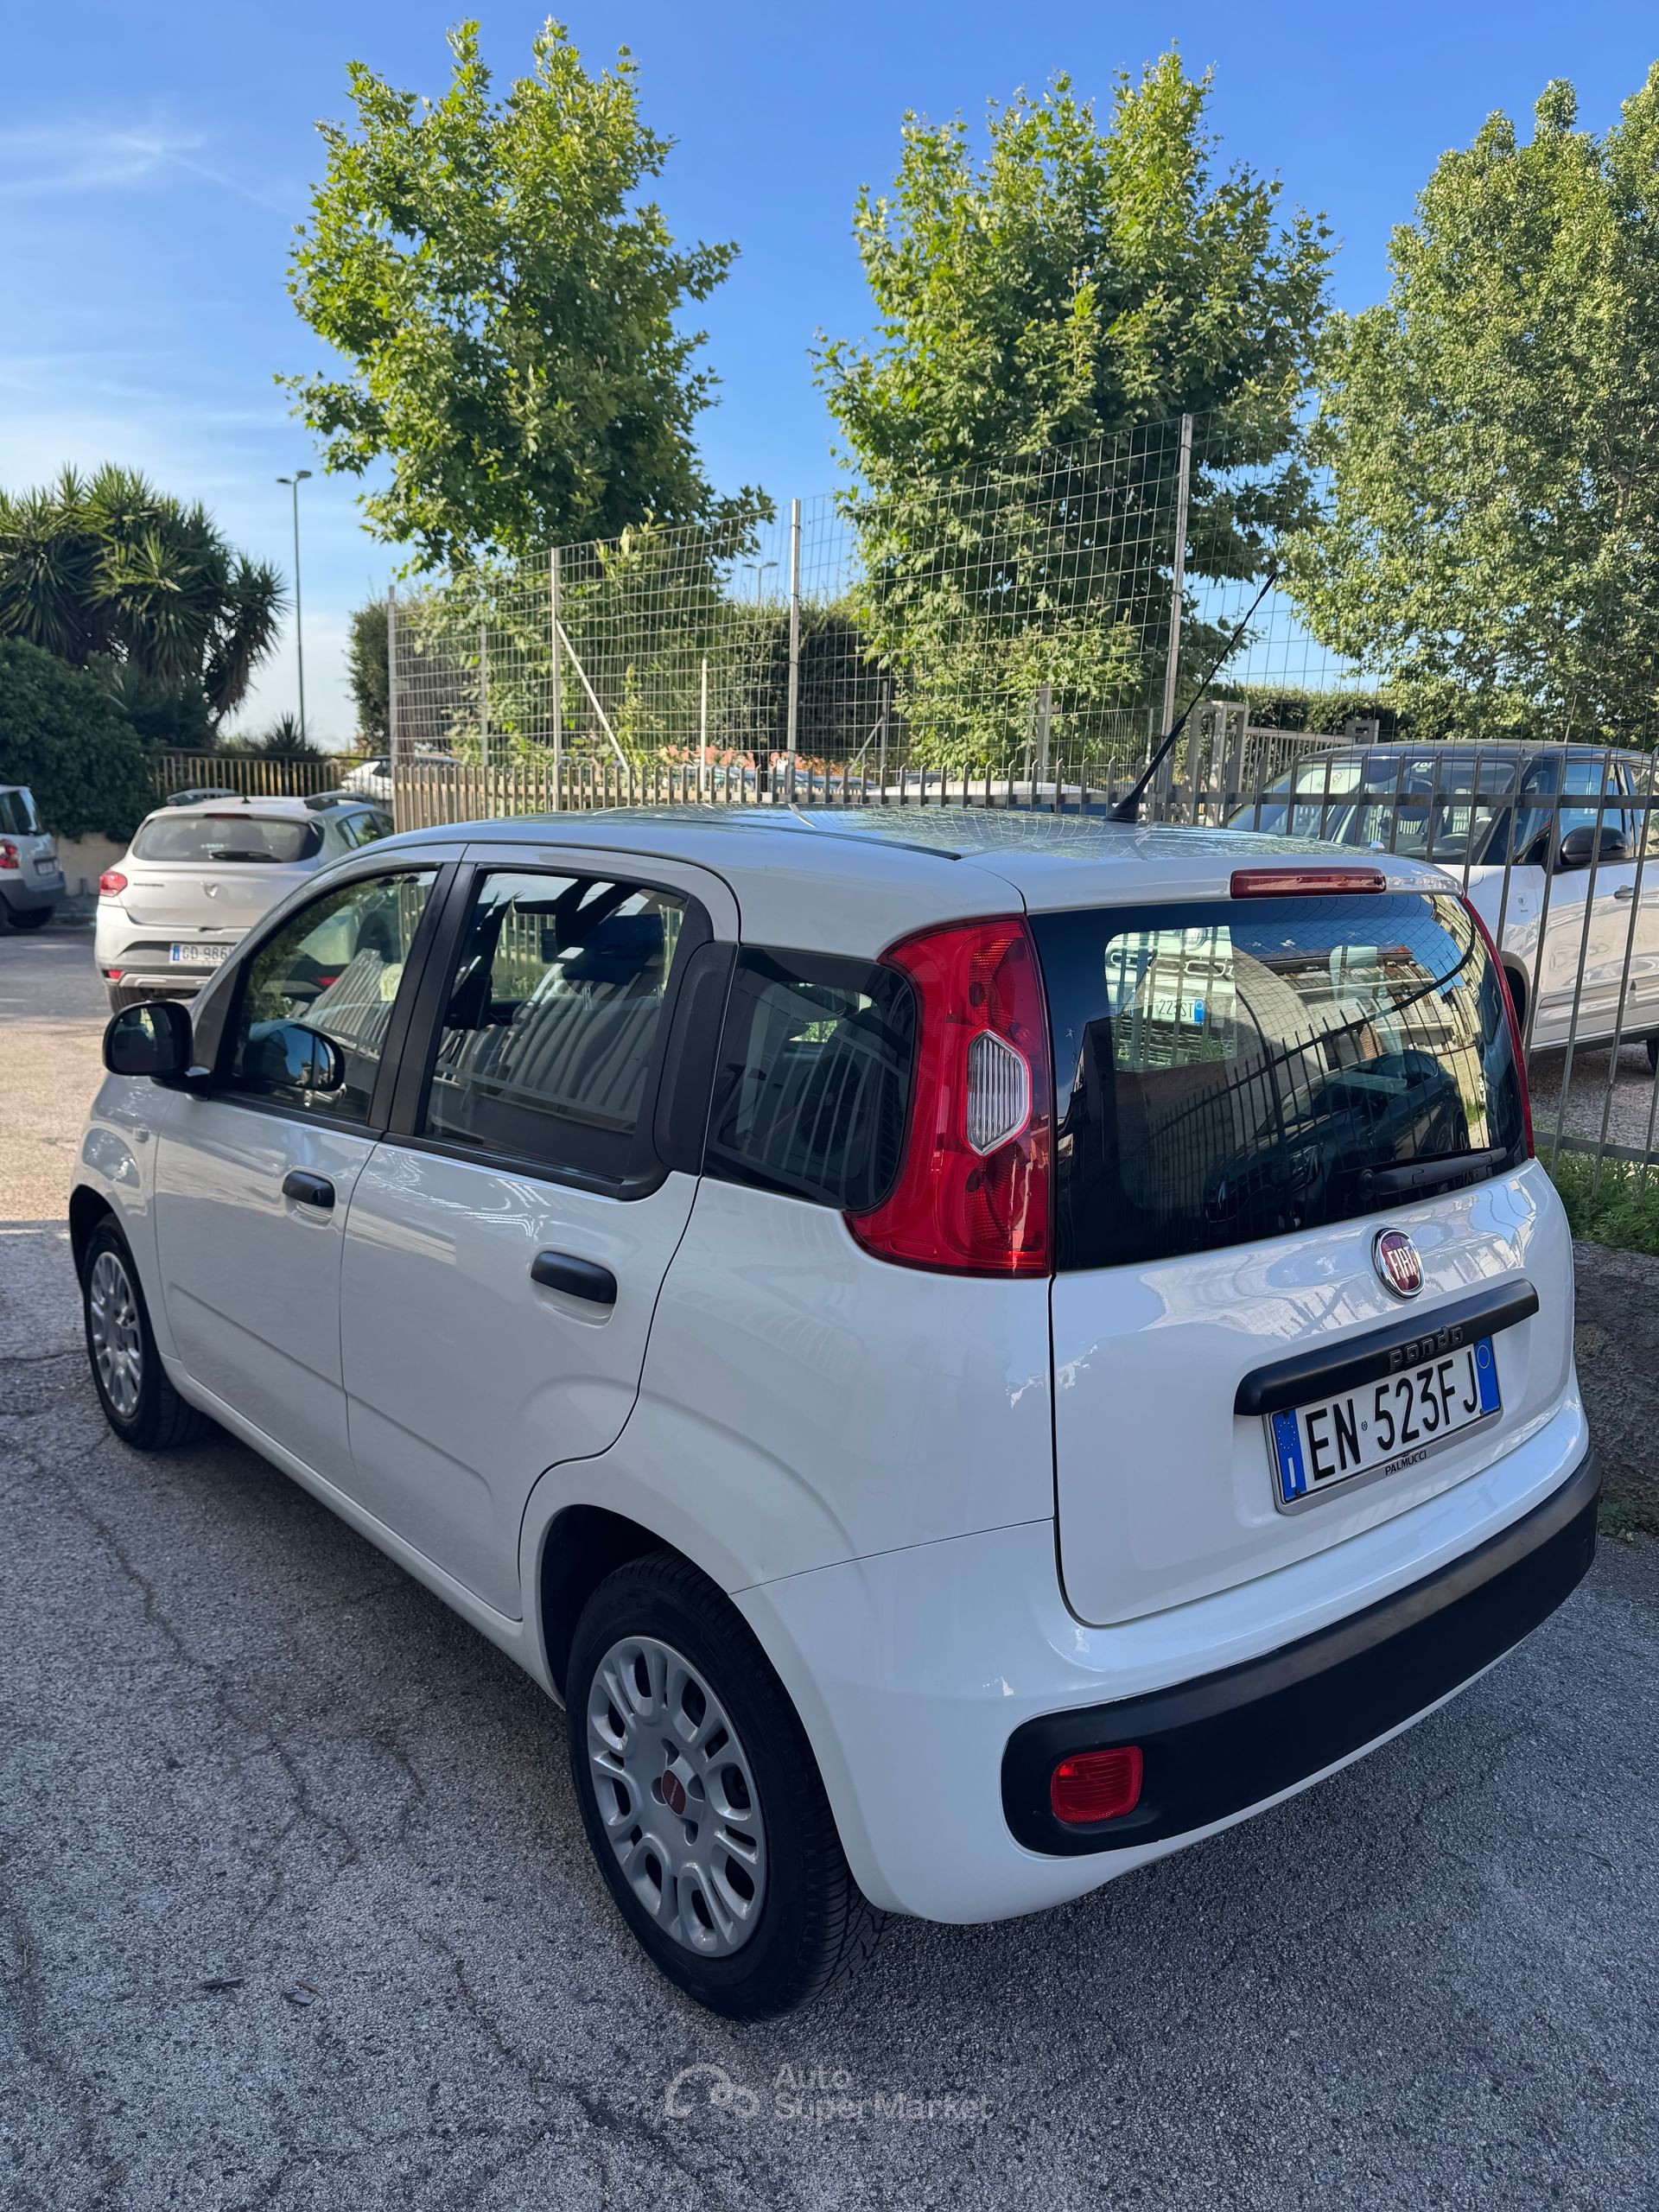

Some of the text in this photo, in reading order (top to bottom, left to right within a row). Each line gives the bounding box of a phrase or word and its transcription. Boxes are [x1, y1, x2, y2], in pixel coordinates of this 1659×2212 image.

[1159, 998, 1194, 1019] 22ST
[1387, 1246, 1417, 1281] FIAT
[1389, 1325, 1464, 1373] panda
[1306, 1398, 1362, 1482] EN
[1374, 1351, 1478, 1451] 523FJ
[1384, 1449, 1427, 1476] PALMUCCI
